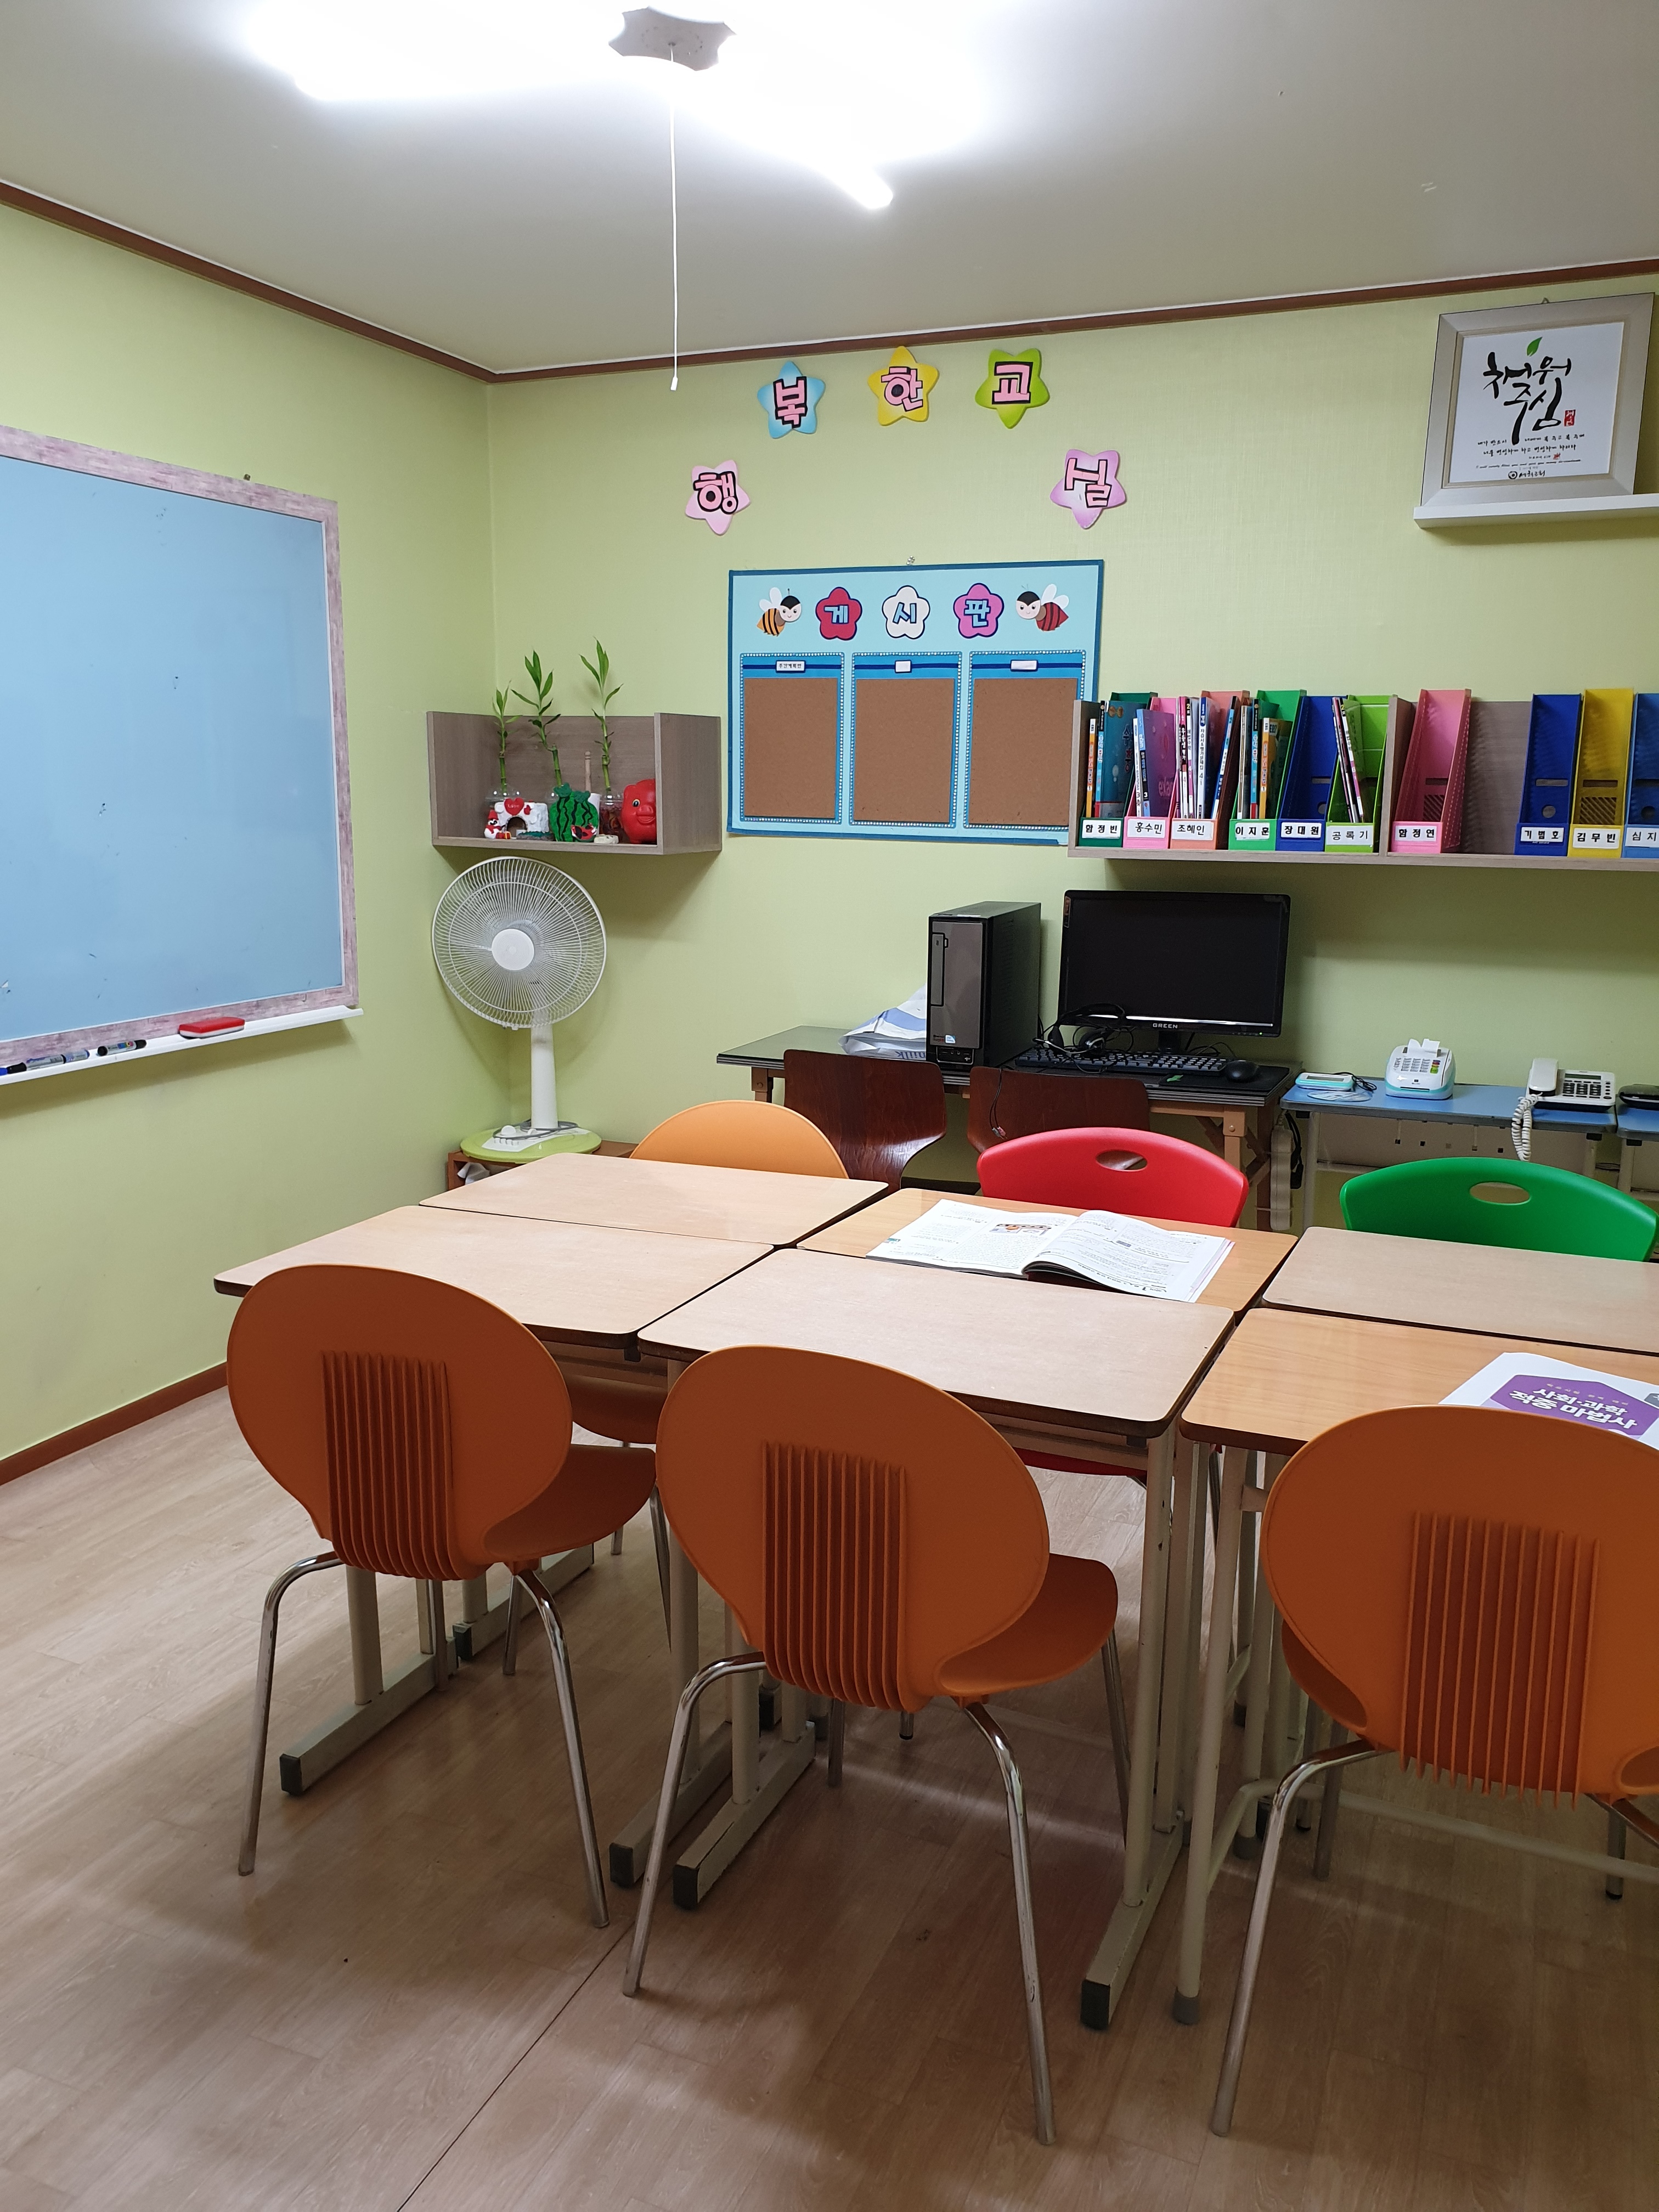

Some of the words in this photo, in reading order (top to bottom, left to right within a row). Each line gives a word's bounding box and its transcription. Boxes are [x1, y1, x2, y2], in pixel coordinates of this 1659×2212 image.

[1135, 822, 1162, 834] 홍수민
[1177, 825, 1205, 836] 조혜인
[1509, 1390, 1558, 1410] 적중
[1560, 1404, 1638, 1429] 마법사
[1533, 1389, 1628, 1417] 사회·과학
